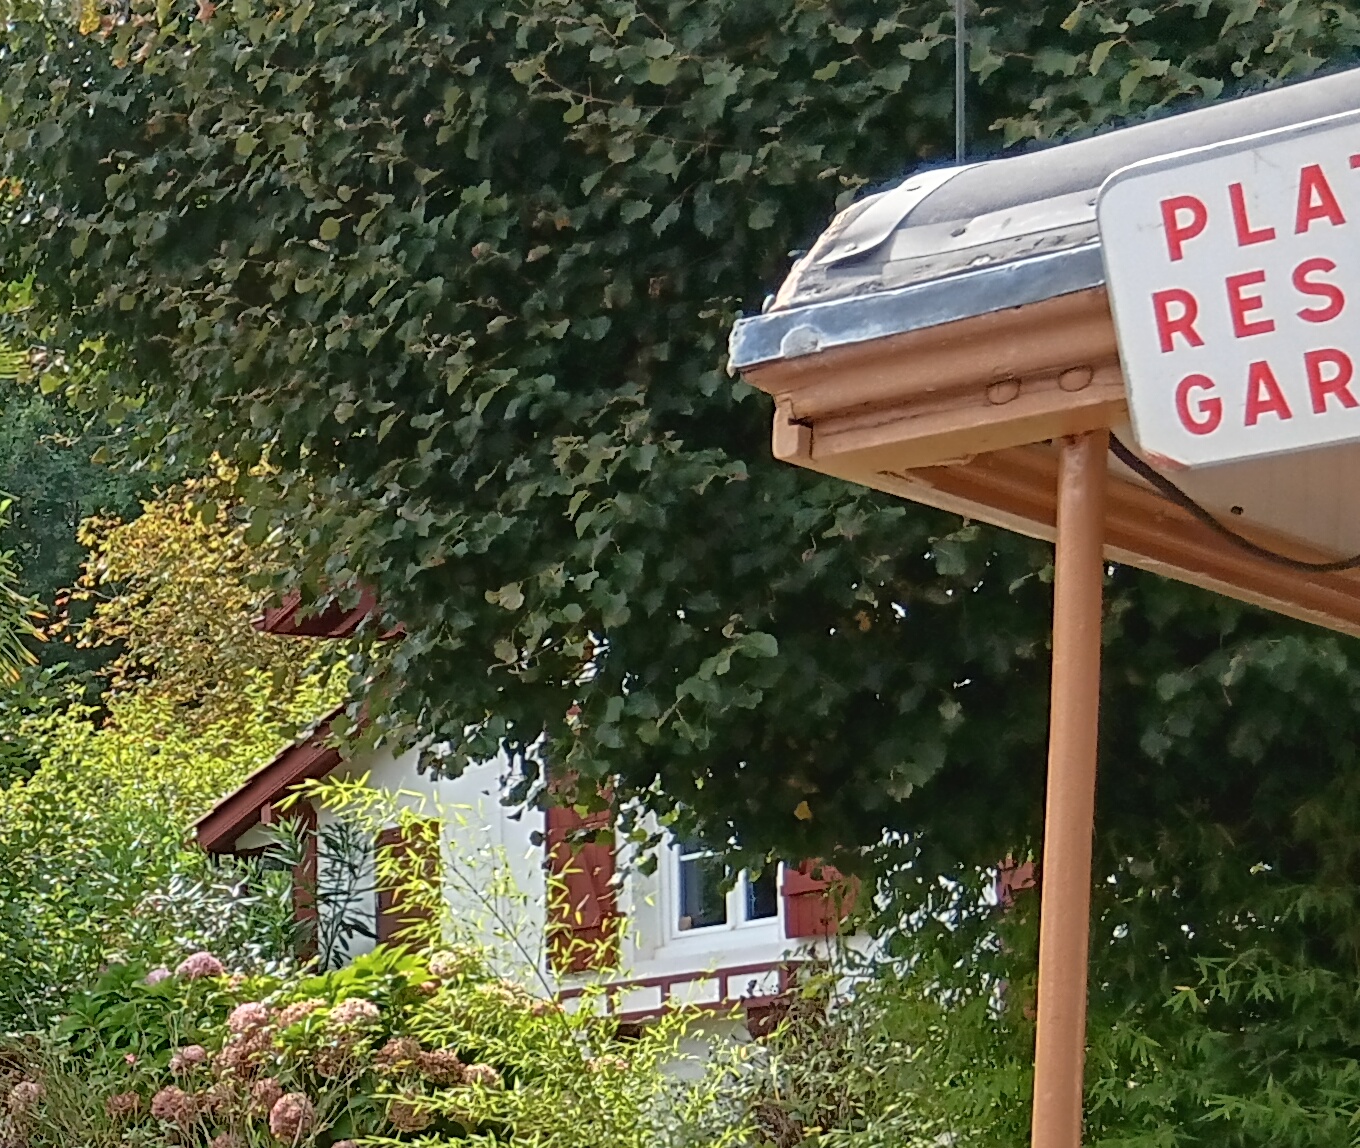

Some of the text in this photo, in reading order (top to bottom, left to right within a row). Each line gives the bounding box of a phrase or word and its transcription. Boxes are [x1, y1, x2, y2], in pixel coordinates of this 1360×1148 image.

[1160, 152, 1360, 262] PLA
[1151, 257, 1346, 354] RES
[1175, 347, 1360, 436] GAR
